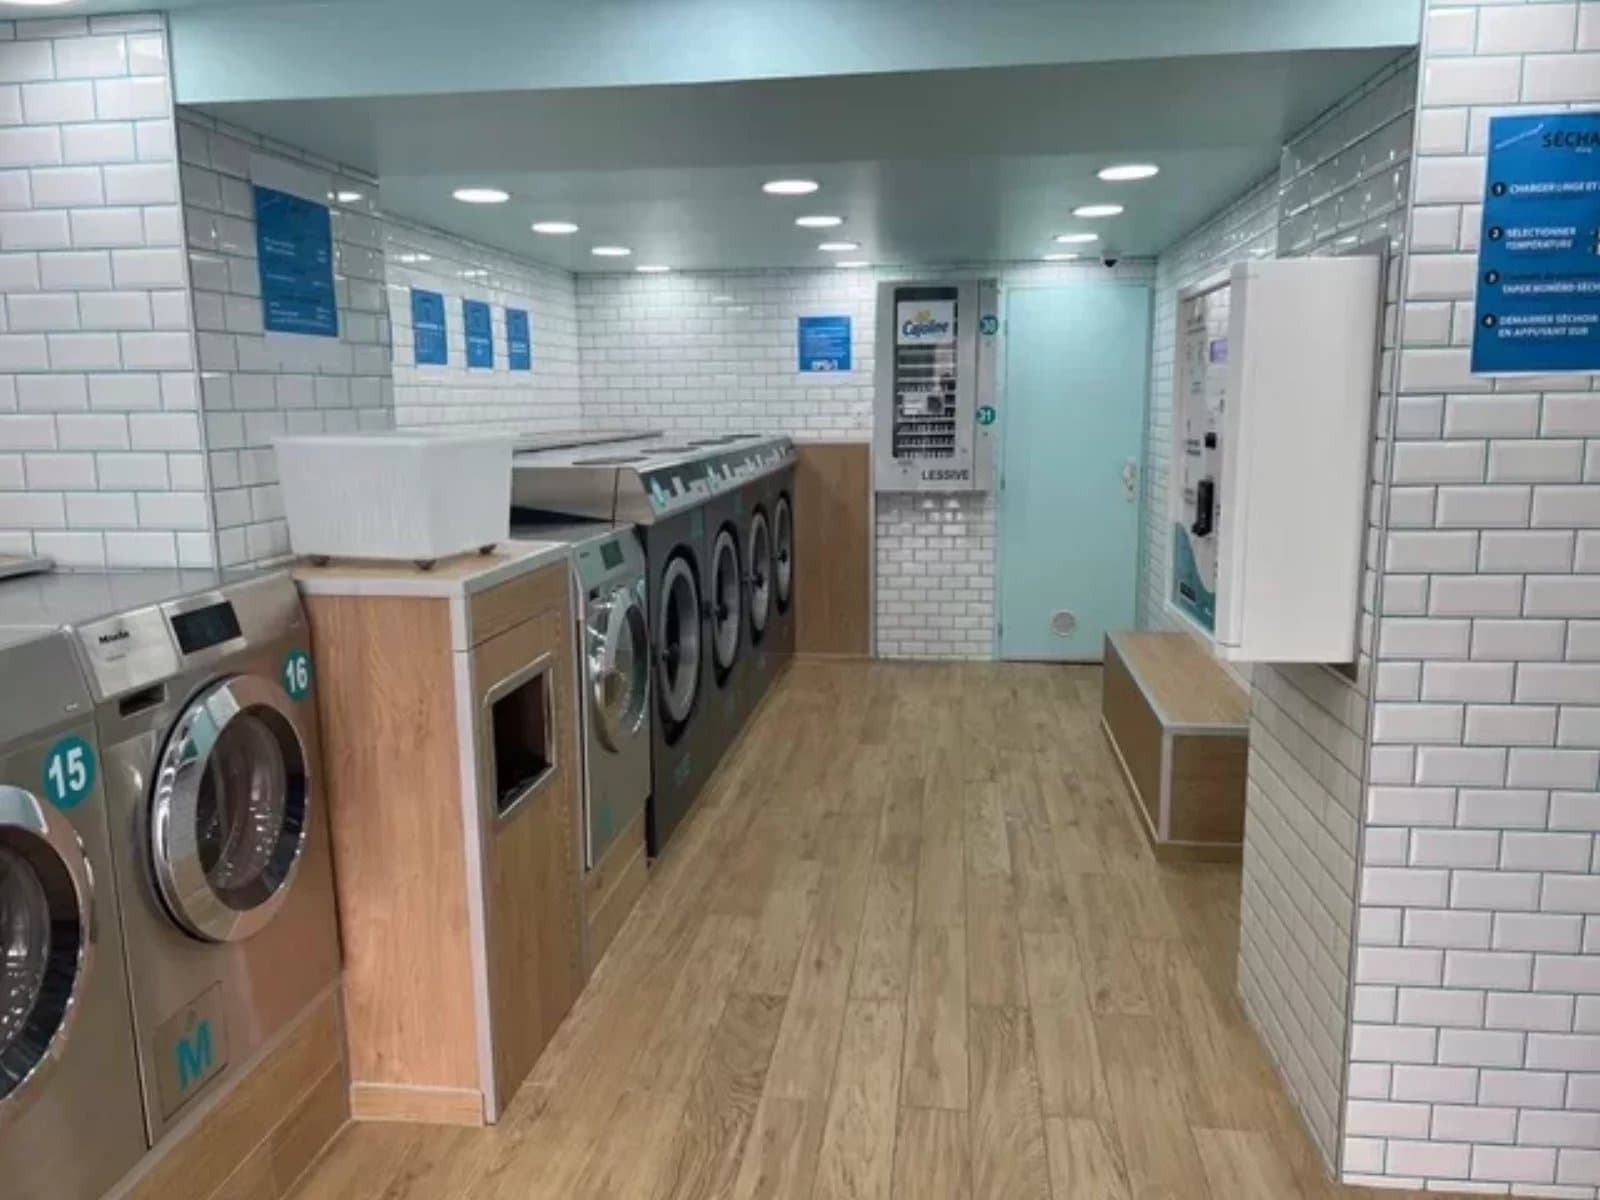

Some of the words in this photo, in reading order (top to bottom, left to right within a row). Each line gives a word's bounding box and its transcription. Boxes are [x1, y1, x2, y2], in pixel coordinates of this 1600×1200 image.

[921, 468, 969, 481] LESSIVE
[285, 657, 309, 693] 16
[48, 746, 88, 800] 15
